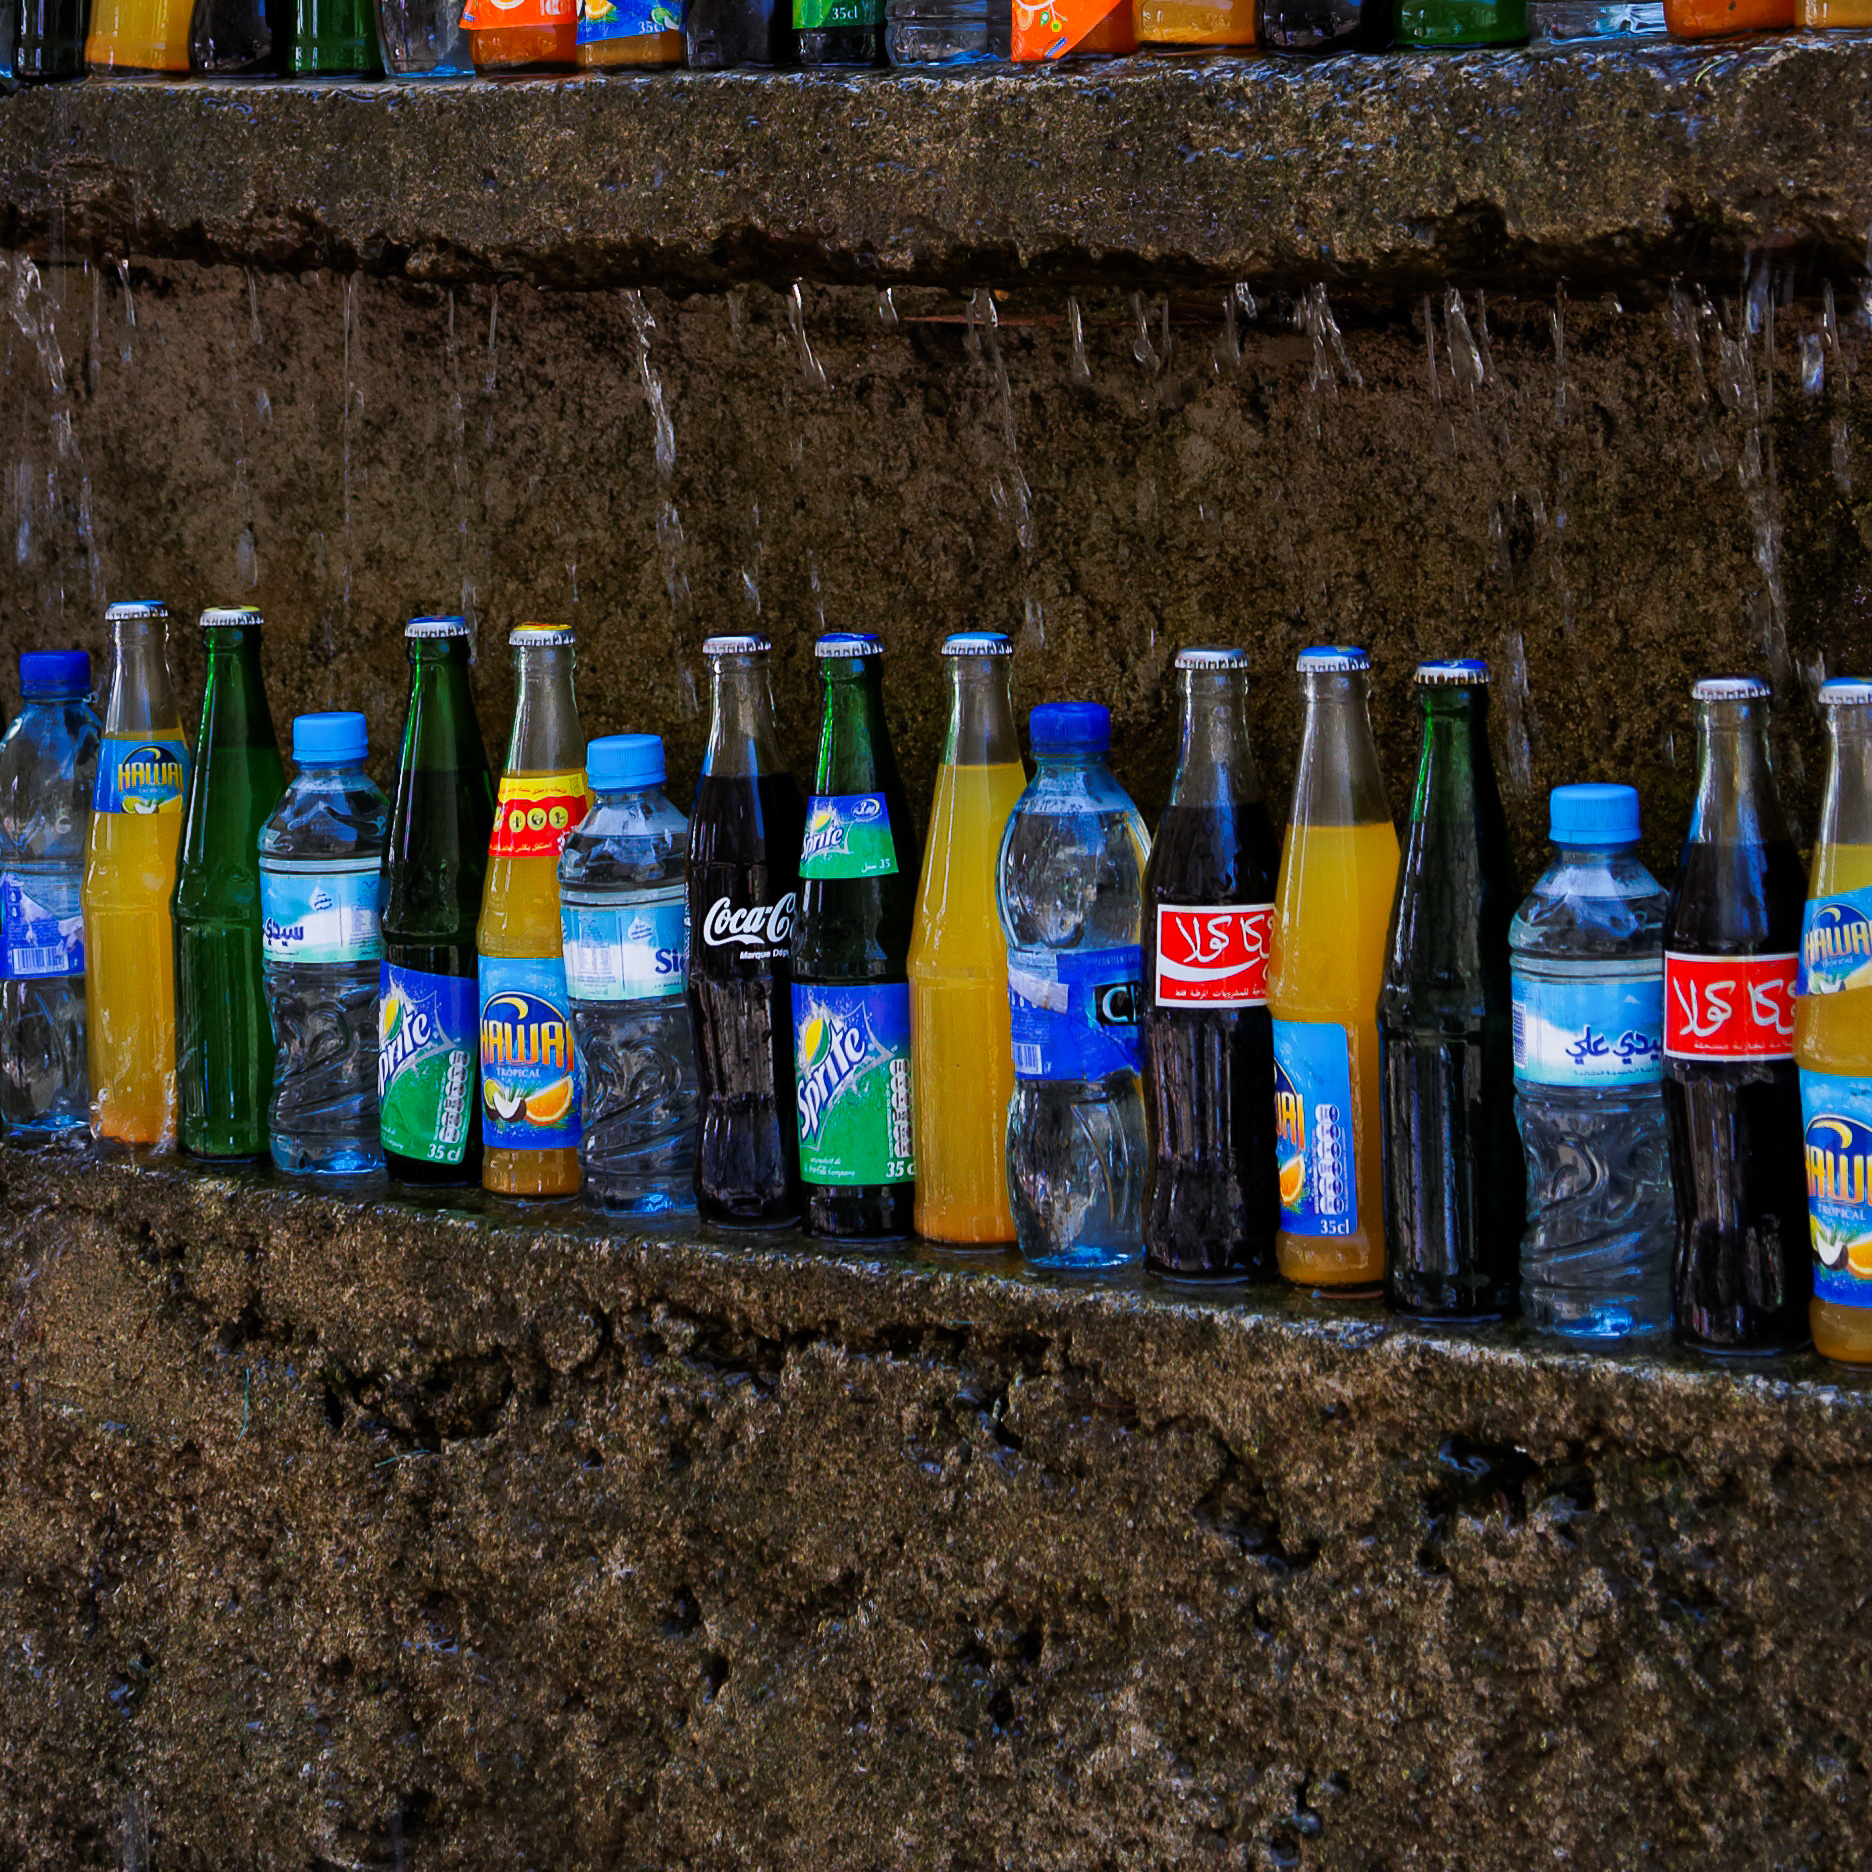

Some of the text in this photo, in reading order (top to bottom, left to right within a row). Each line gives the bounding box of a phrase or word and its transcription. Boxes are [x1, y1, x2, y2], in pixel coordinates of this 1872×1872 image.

[831, 6, 859, 20] 35cl
[117, 762, 185, 794] HAWAI
[800, 825, 844, 866] Sprite
[879, 858, 891, 869] 35
[702, 891, 797, 947] Coca-C
[1175, 915, 1233, 964] كولا
[739, 948, 772, 961] Marque
[1672, 976, 1737, 1037] كولا
[377, 1011, 431, 1098] prite
[1565, 1025, 1610, 1065] علي
[496, 1066, 541, 1078] TROPICAL
[796, 1018, 866, 1143] Sprite
[427, 1143, 444, 1159] 35
[885, 1161, 905, 1179] 35
[1816, 1203, 1866, 1221] TROPICAL
[1319, 1218, 1350, 1235] 35cl
